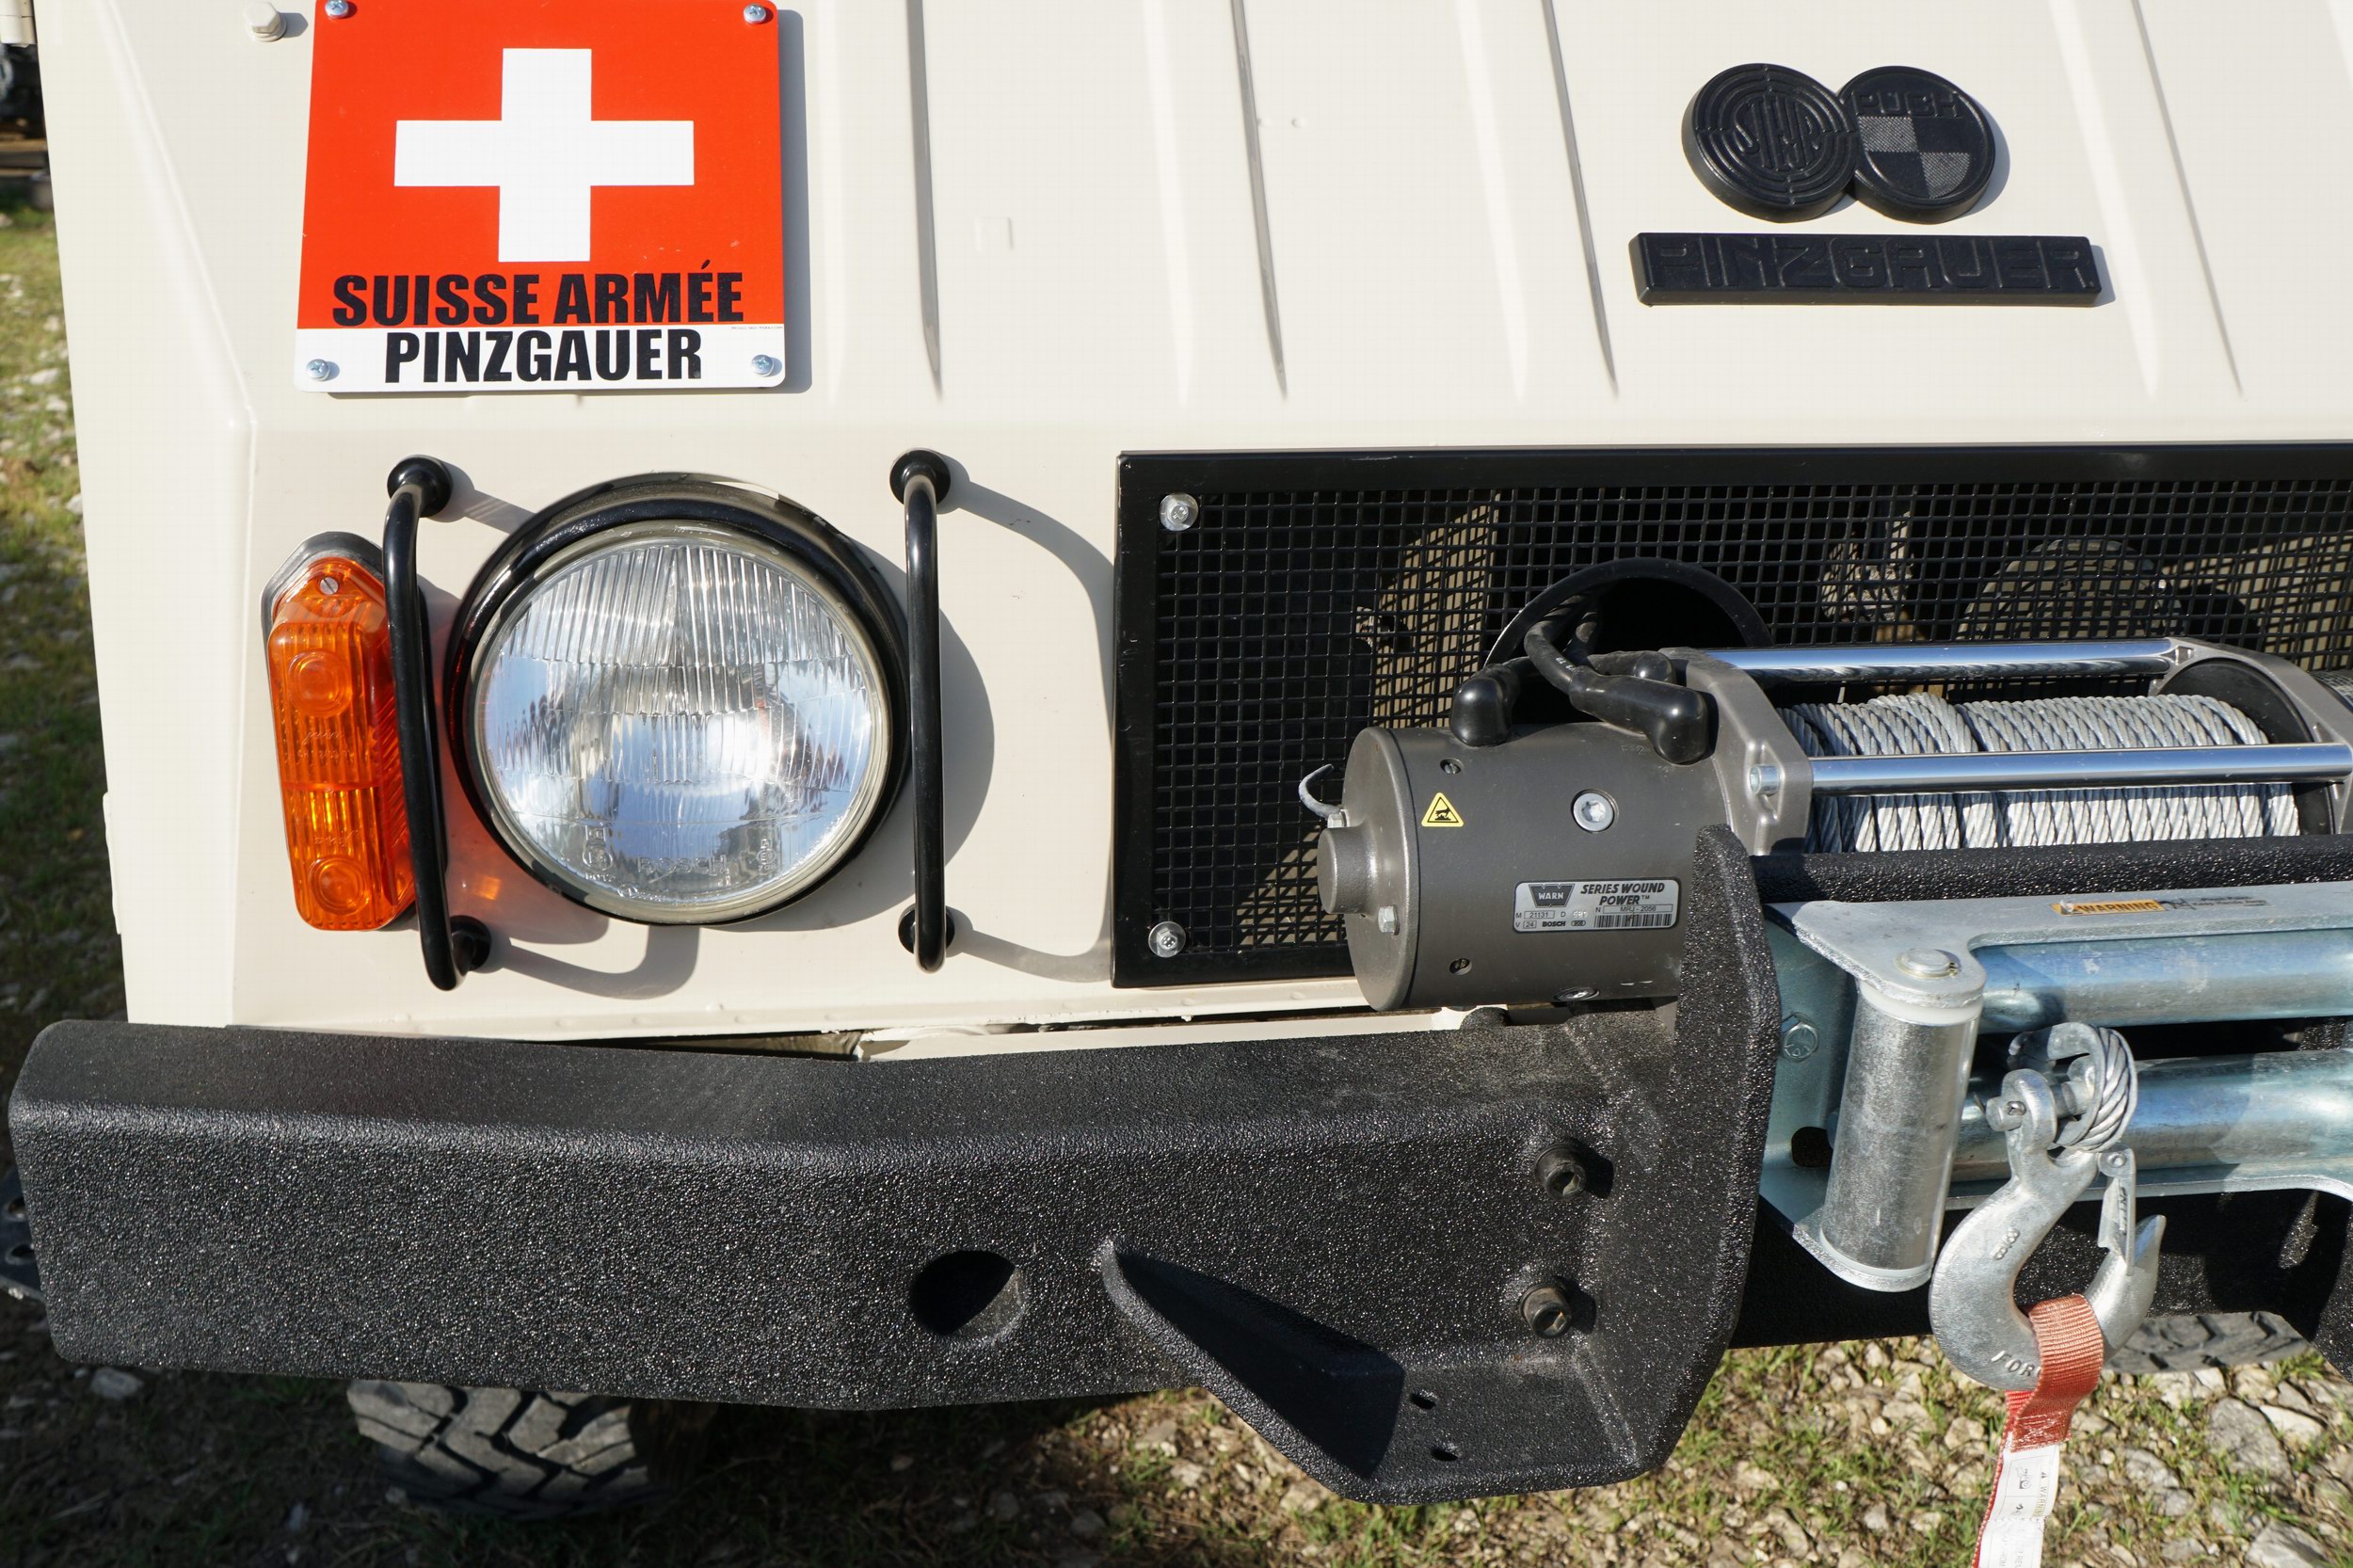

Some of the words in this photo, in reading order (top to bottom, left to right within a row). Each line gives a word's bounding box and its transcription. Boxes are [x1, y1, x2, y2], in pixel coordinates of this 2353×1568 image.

[1644, 237, 2095, 288] PINZGAUER
[332, 274, 540, 327] SUISSE
[553, 260, 744, 324] ARMÉE
[384, 328, 702, 383] PINZGAUER
[637, 855, 728, 874] BOSCH
[1580, 883, 1619, 894] SERIES
[1621, 882, 1665, 893] WOUND
[2081, 901, 2159, 913] WARNING
